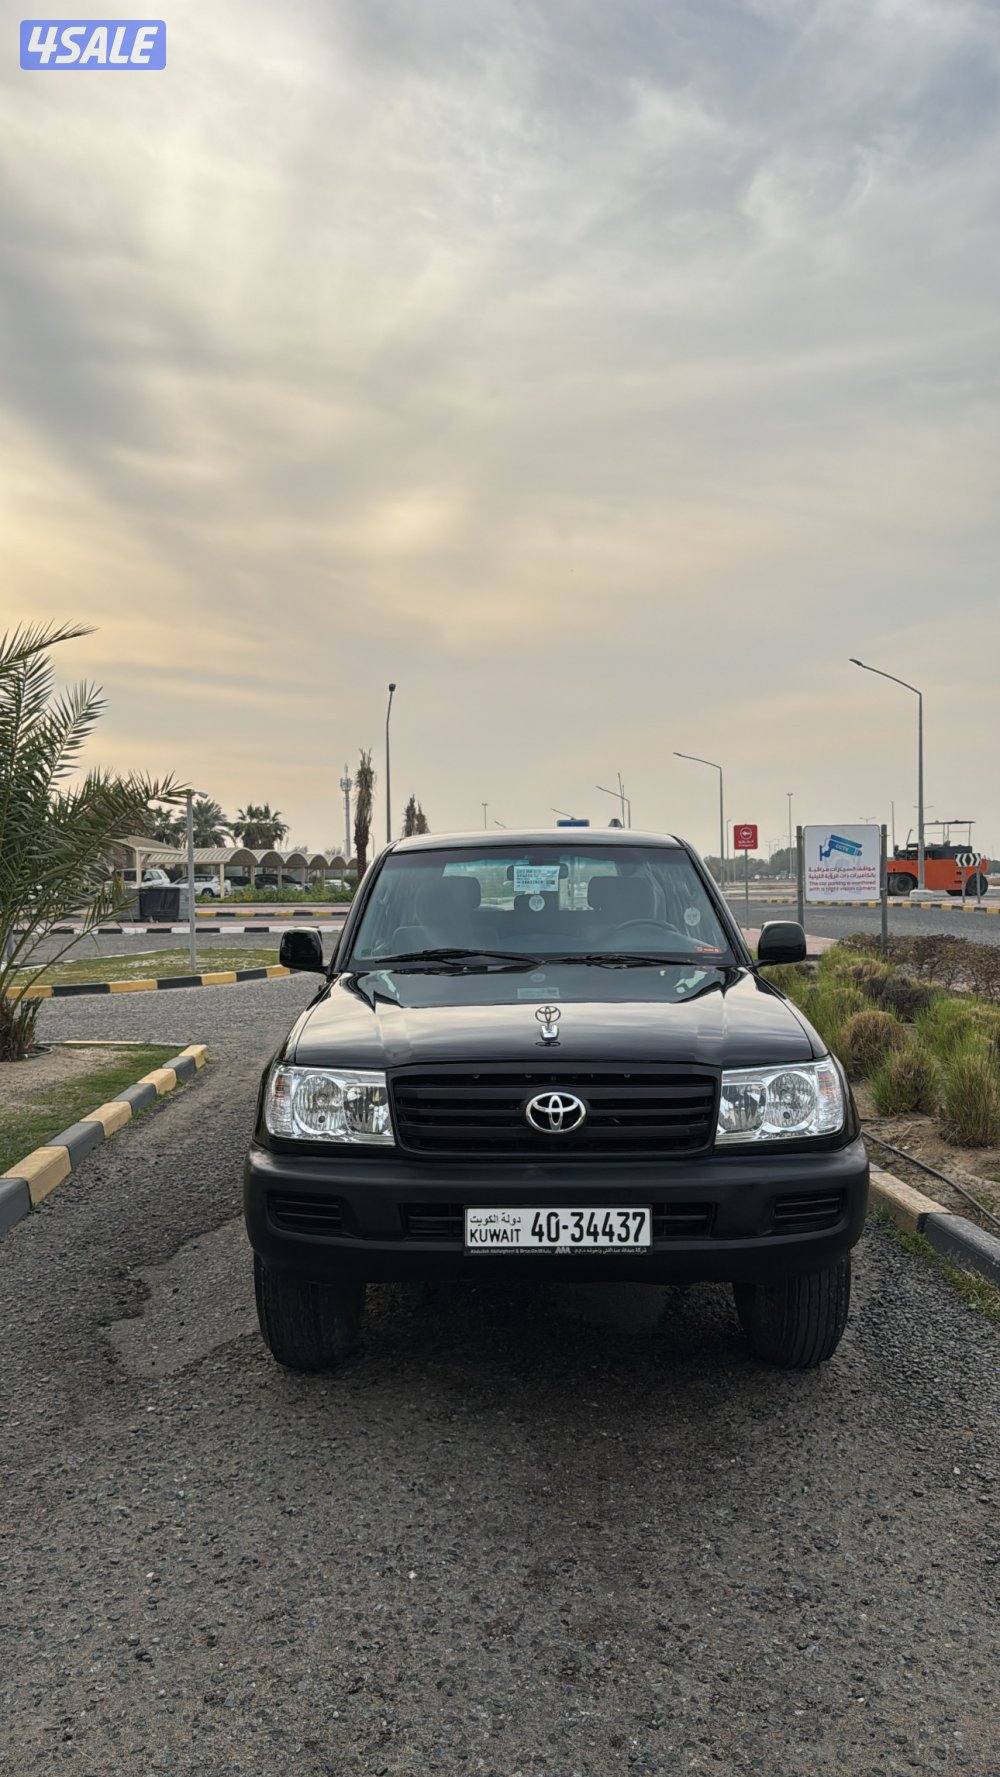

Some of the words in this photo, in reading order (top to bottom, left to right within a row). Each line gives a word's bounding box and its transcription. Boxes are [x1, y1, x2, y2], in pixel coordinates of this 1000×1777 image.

[469, 1213, 498, 1227] الكويت
[501, 1212, 521, 1226] دولة
[531, 1211, 646, 1243] 40-34437
[469, 1229, 521, 1243] KUWAIT
